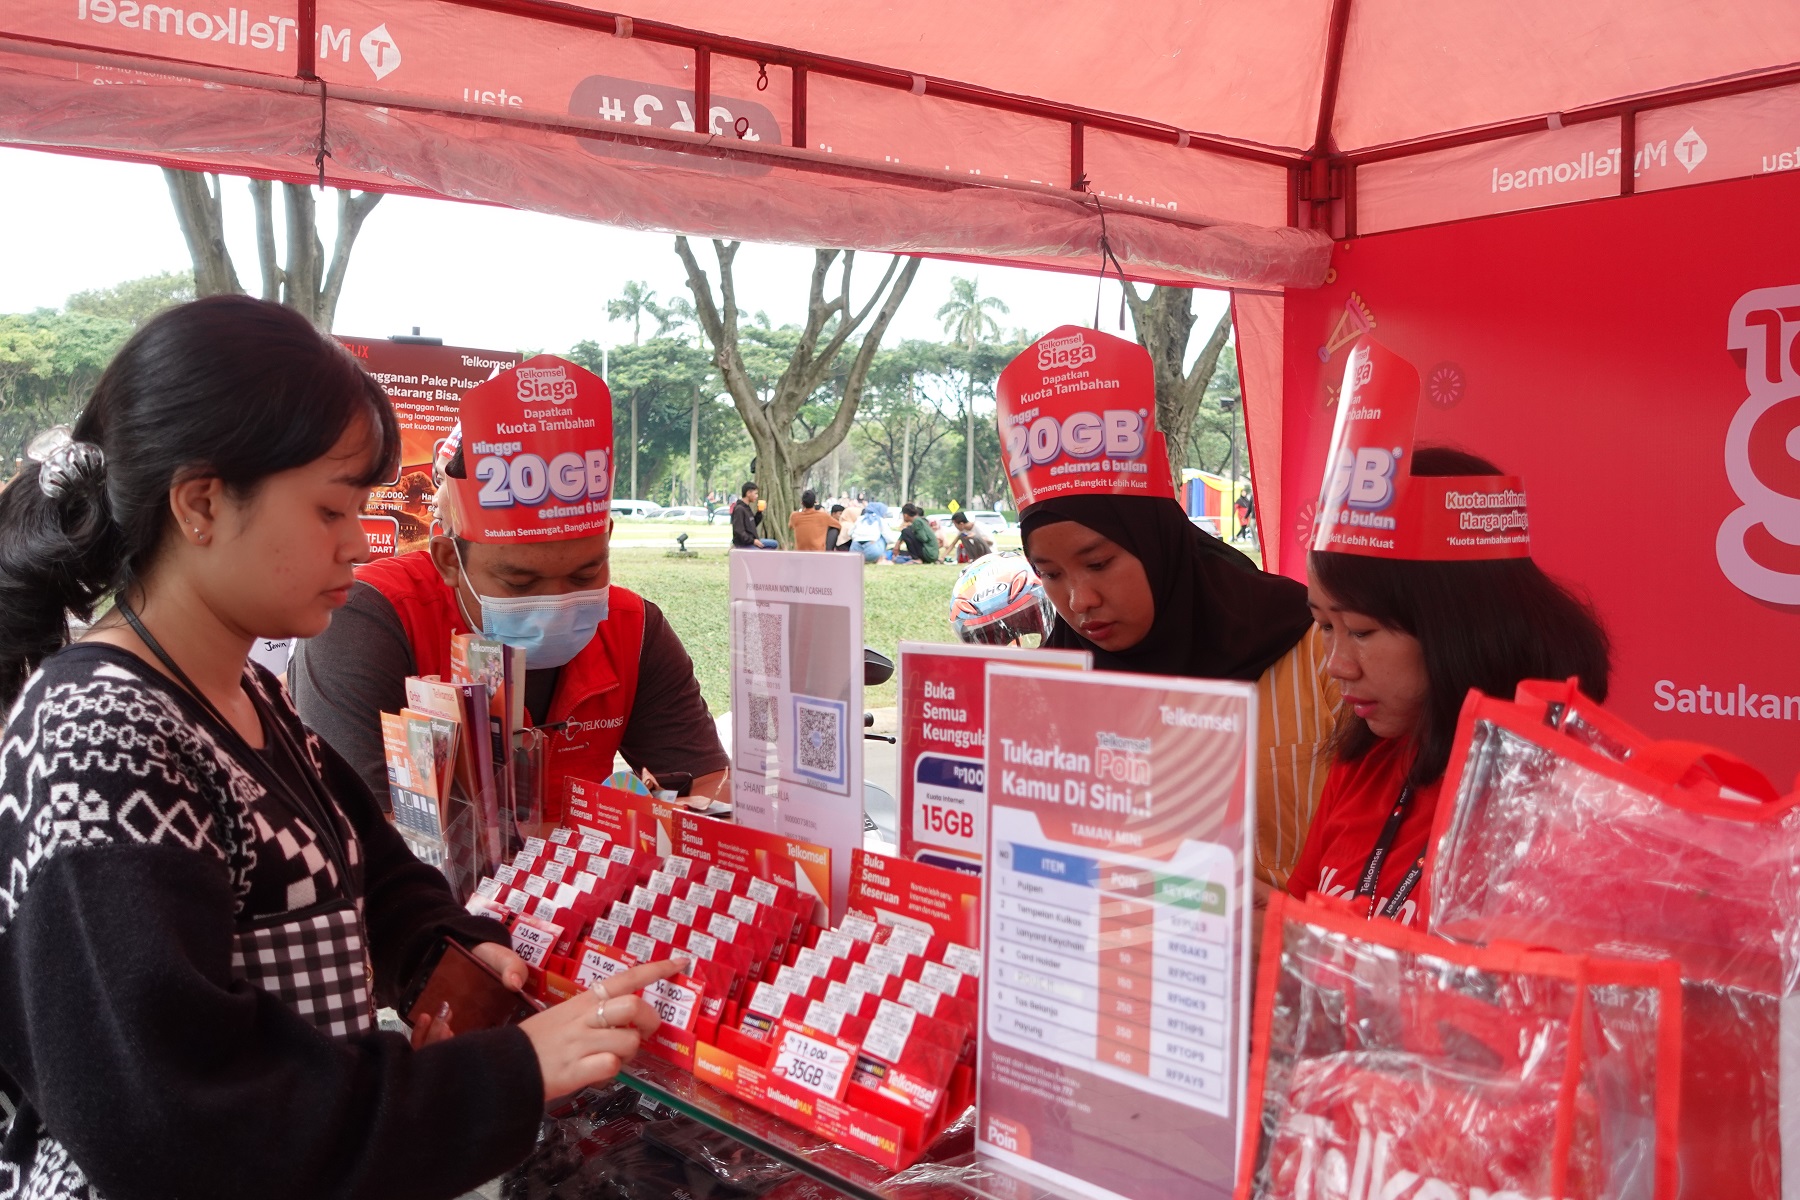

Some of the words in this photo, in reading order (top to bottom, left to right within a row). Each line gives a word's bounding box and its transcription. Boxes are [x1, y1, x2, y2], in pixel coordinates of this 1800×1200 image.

[1040, 334, 1082, 350] Telkomsel
[461, 355, 516, 371] Telkomsel
[1039, 345, 1094, 368] Siaga
[421, 374, 448, 387] Pake
[518, 367, 564, 380] Telkomsel
[1042, 369, 1089, 385] Dapatkan
[435, 389, 461, 401] Bisa.
[519, 379, 576, 402] Siaga
[1020, 387, 1052, 404] Kuota
[1054, 379, 1120, 395] Tambahan
[396, 402, 434, 412] pelanggan
[523, 406, 573, 420] Dapatkan
[414, 413, 453, 423] langganan
[414, 423, 435, 431] kuota
[496, 419, 536, 435] Kuota
[538, 417, 596, 431] Tambahan
[472, 440, 522, 456] Hingga
[1050, 461, 1100, 477] selama
[1102, 459, 1110, 472] 6
[1112, 459, 1148, 473] bulan
[1032, 480, 1073, 496] Semangat,
[1074, 477, 1108, 489] Bangkit
[1108, 479, 1130, 488] Lebih
[1130, 479, 1147, 489] Kuat
[375, 491, 409, 501] 62.000,-
[1446, 492, 1487, 509] Kuota
[1487, 490, 1518, 508] makin
[538, 504, 585, 519] selama
[586, 502, 592, 514] 6
[484, 527, 516, 537] Satukan
[517, 525, 563, 537] Semangat,
[564, 521, 591, 532] Bangkit
[1341, 510, 1349, 524] 6
[1350, 510, 1396, 530] bulan
[1460, 512, 1500, 532] Harga
[1342, 533, 1368, 546] Lebih
[1369, 537, 1394, 549] Kuat
[1476, 535, 1511, 545] tambahan
[780, 584, 804, 594] NONTUNAI
[809, 587, 833, 596] CASHLESS
[470, 642, 501, 654] Telkomsel
[924, 680, 955, 701] Buka
[1653, 679, 1800, 721] Satukan
[922, 701, 967, 723] Semua
[1158, 705, 1239, 732] Telkomsel
[1097, 732, 1152, 752] Telkomsel
[1000, 738, 1090, 774] Tukarkan
[1096, 746, 1152, 786] Poin
[571, 784, 585, 796] Buka
[1002, 769, 1059, 802] Kamu
[1064, 778, 1086, 806] Di
[570, 794, 588, 808] Semua
[942, 795, 965, 805] Internet
[569, 806, 593, 821] Keseruan
[922, 804, 974, 838] 15GB
[681, 817, 698, 832] Buka
[1071, 822, 1112, 841] TAMAN
[681, 831, 703, 846] Semua
[681, 844, 711, 862] Keseruan
[786, 842, 827, 866] Telkomsel
[863, 853, 885, 871] Buka
[862, 868, 891, 888] Semua
[1041, 857, 1066, 874] ITEM
[1110, 871, 1138, 890] POIN
[1360, 848, 1384, 893] Telkomsel
[860, 883, 899, 906] Keseruan
[1017, 879, 1043, 893] Pulpen
[1386, 869, 1419, 914] Telkomsel
[515, 943, 535, 961] 4GB
[1016, 949, 1034, 961] Card
[1014, 1018, 1043, 1039] Payung
[697, 1058, 735, 1081] InternetMAX
[788, 1058, 824, 1087] 35GB
[887, 1068, 939, 1105] Telkomsel
[767, 1086, 813, 1116] UnlimitedMAX
[849, 1122, 897, 1154] InternetMAX
[988, 1125, 1018, 1152] Poin
